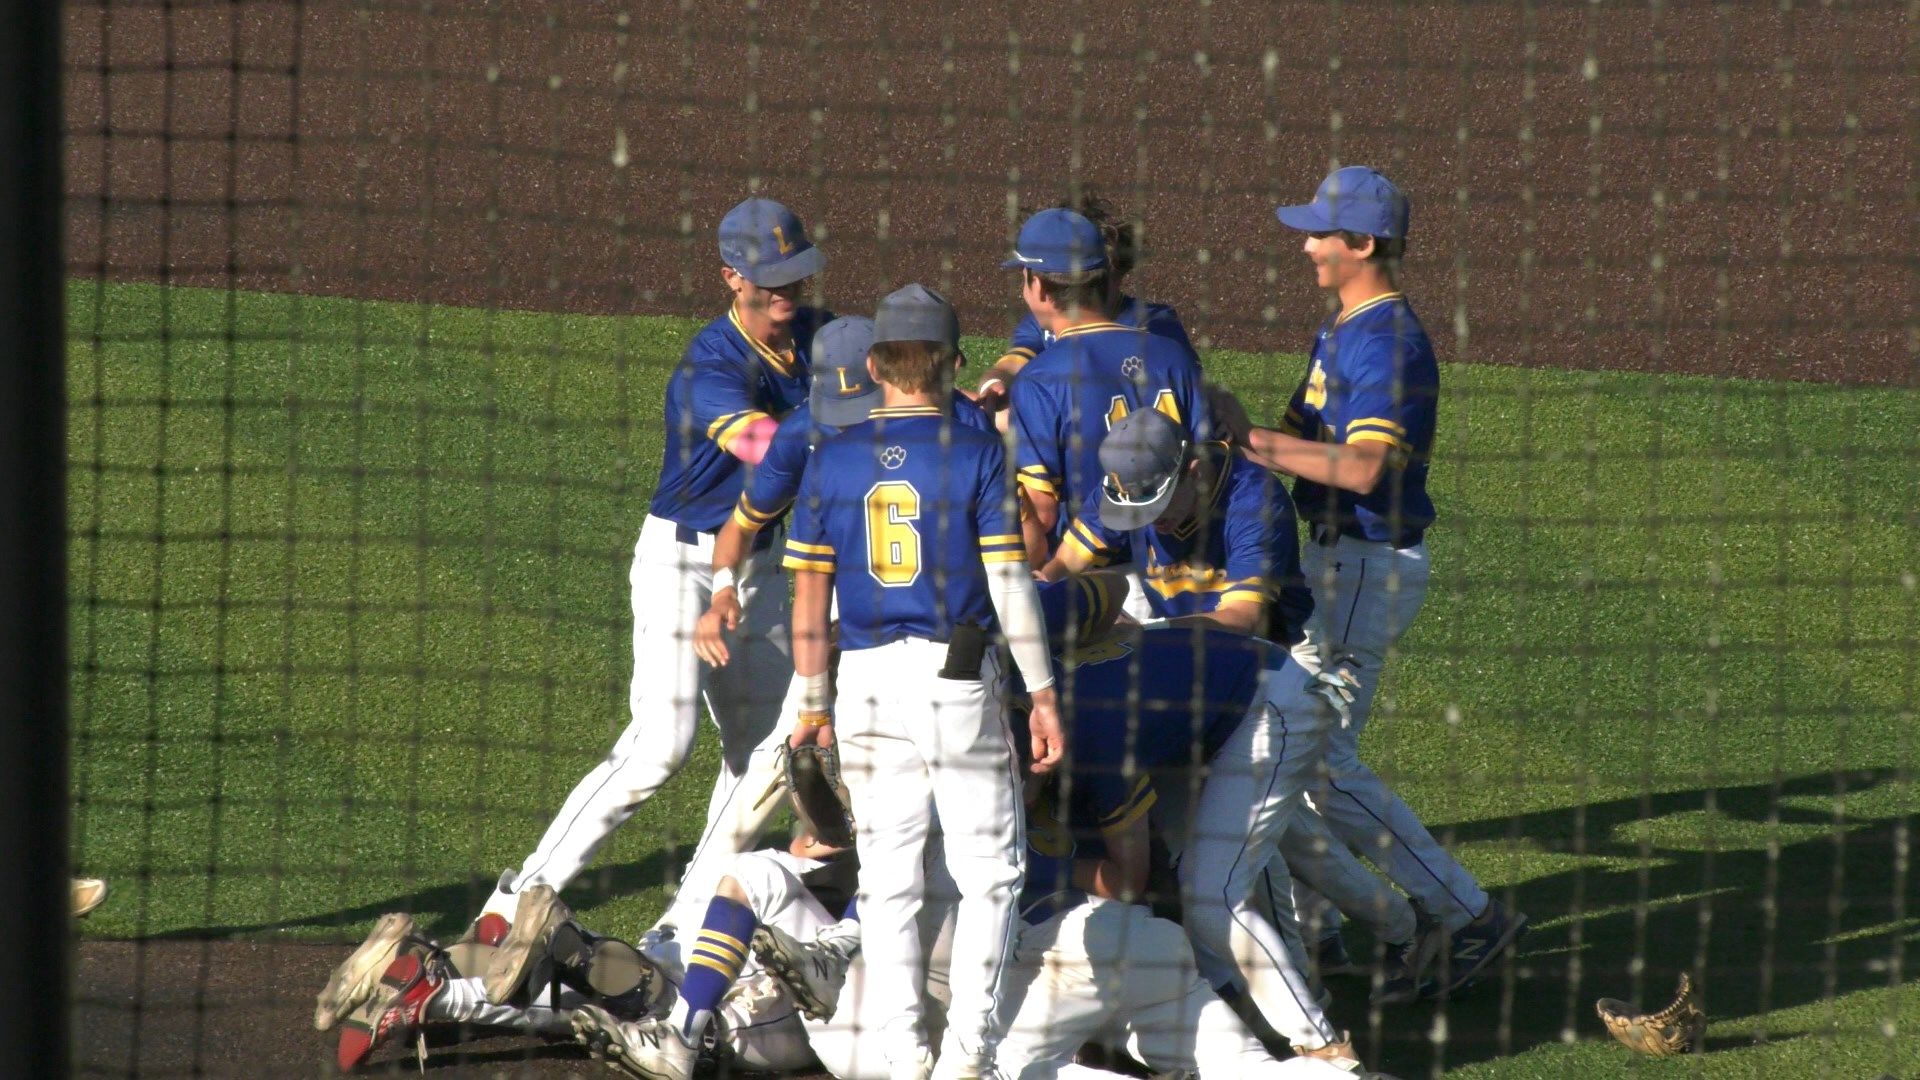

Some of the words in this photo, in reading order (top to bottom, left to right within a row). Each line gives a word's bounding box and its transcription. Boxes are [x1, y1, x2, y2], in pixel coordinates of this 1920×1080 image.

[837, 367, 861, 392] L
[864, 480, 921, 587] 6
[812, 956, 828, 980] N
[638, 1029, 660, 1049] N
